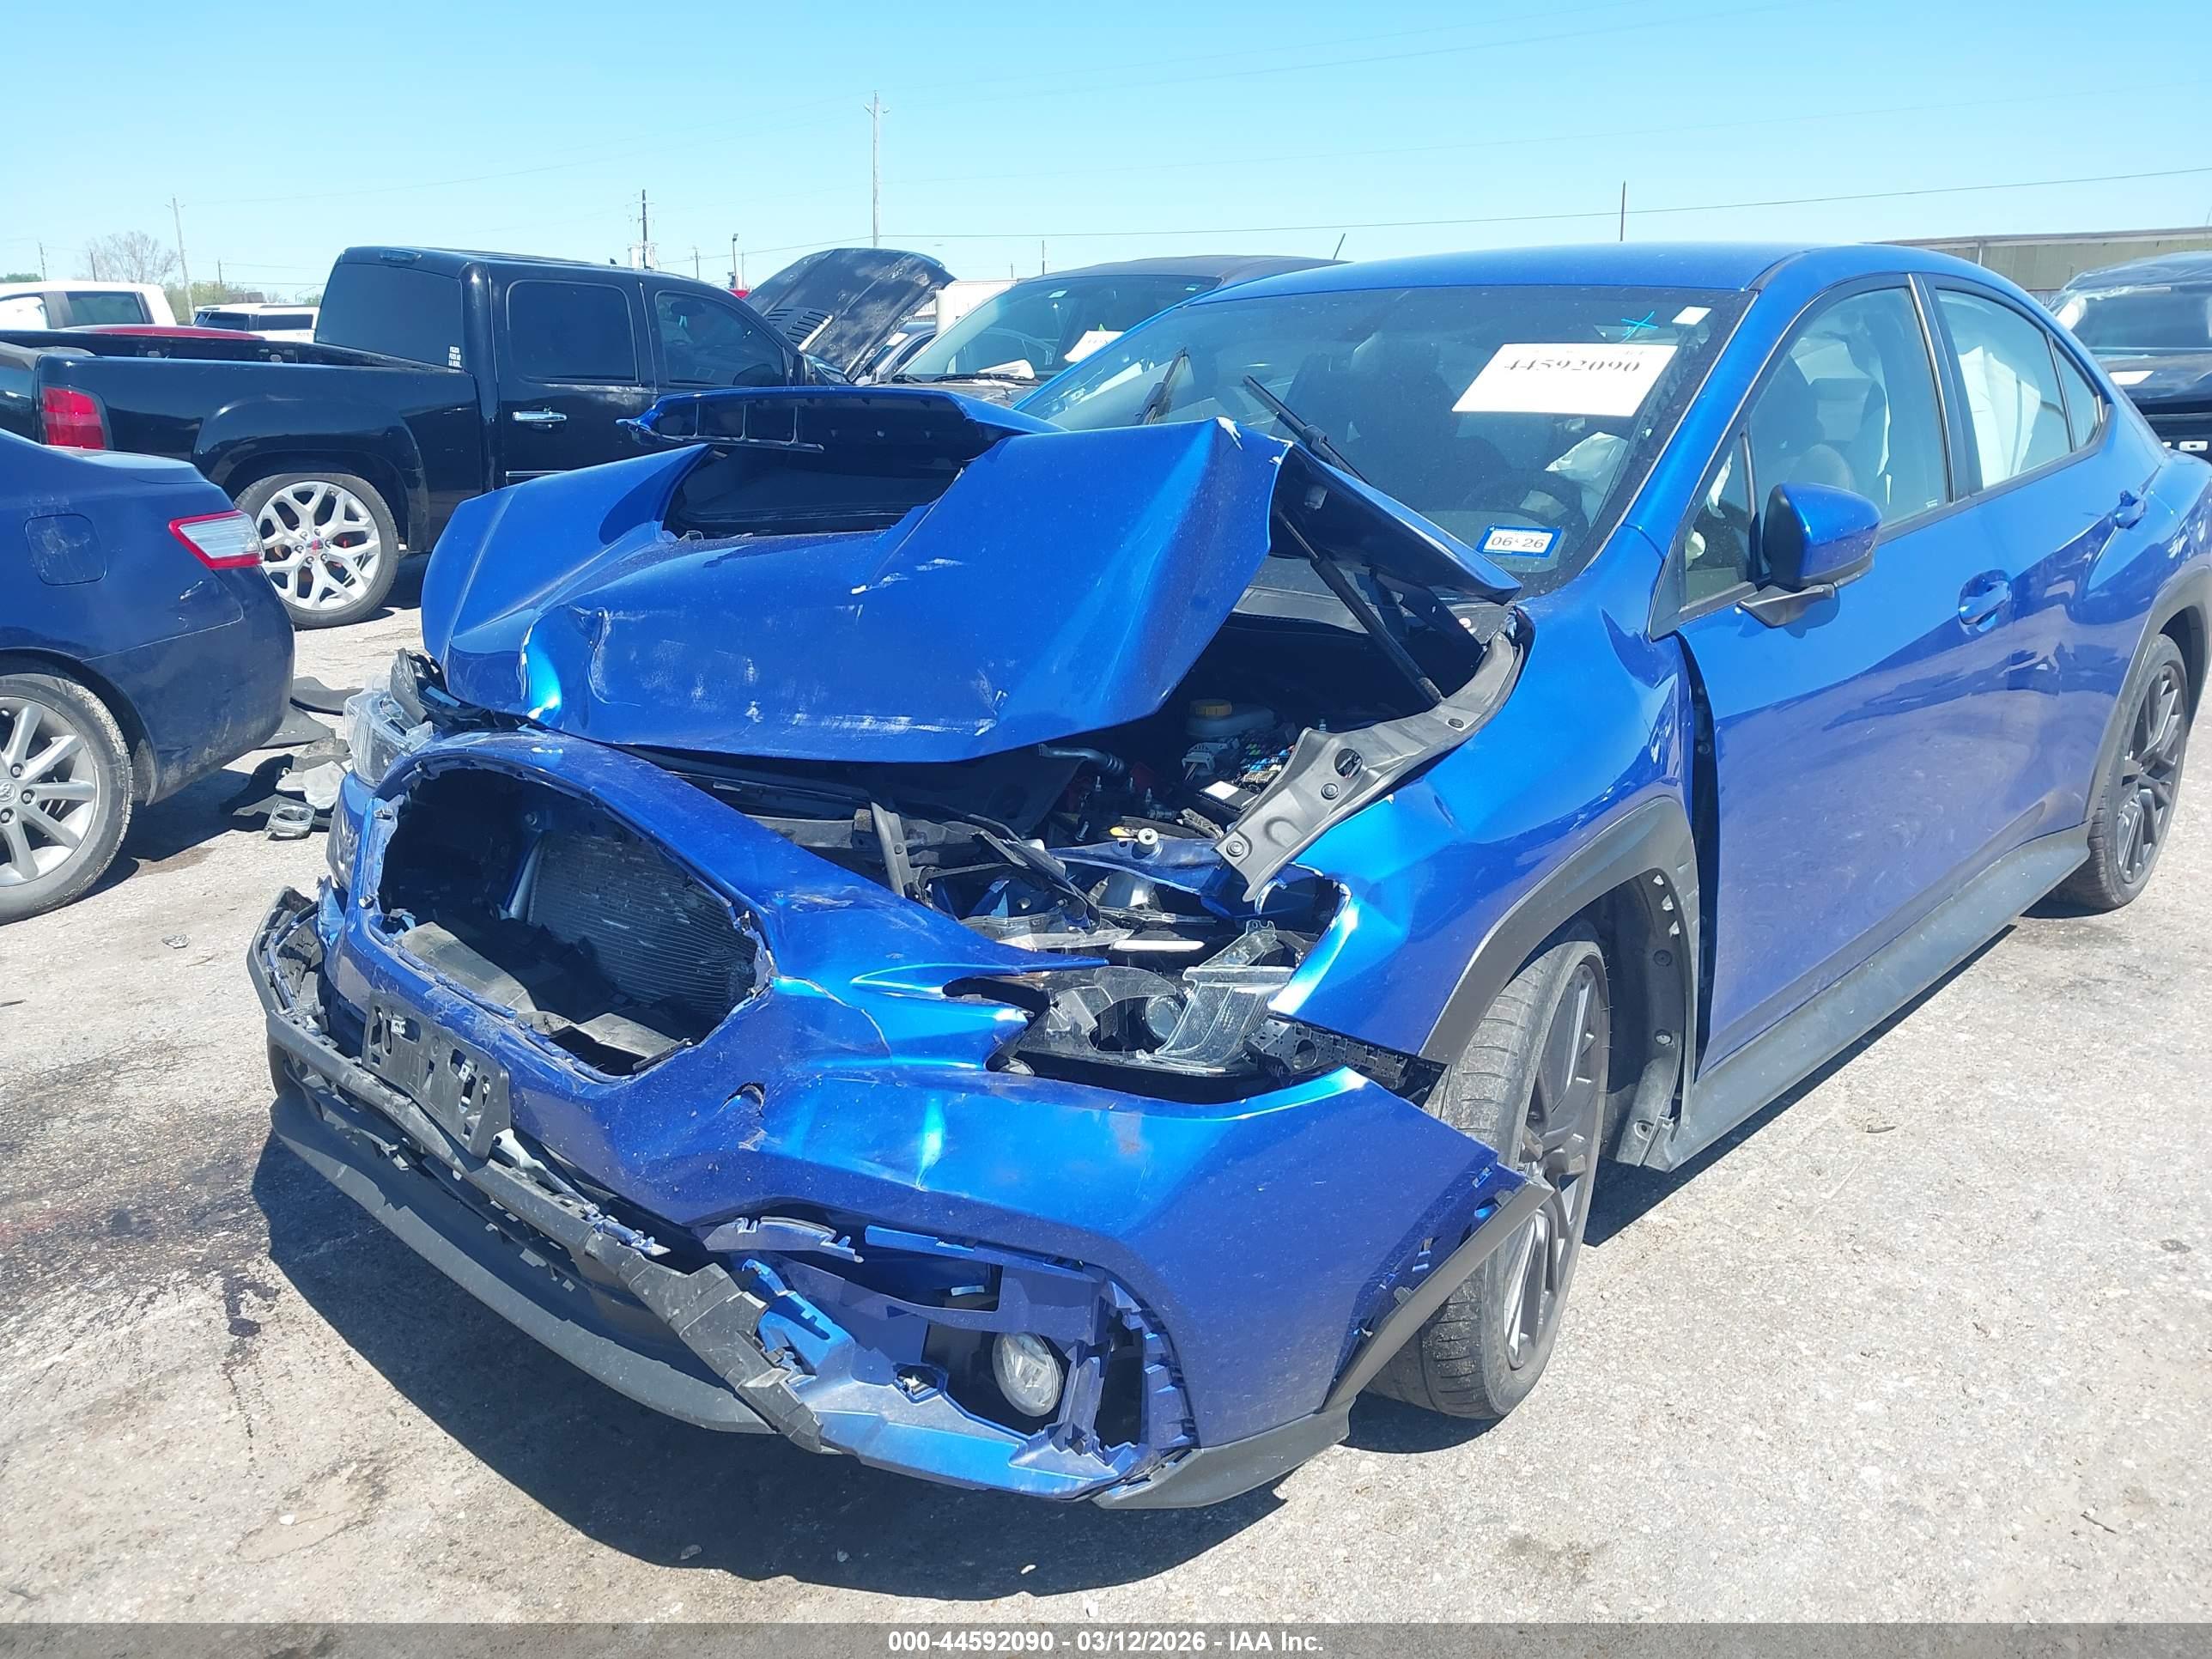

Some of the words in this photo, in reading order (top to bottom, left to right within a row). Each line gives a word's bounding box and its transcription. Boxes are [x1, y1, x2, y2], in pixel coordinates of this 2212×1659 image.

[1504, 359, 1641, 371] 44592090
[1491, 536, 1513, 546] 06
[1522, 538, 1545, 548] 26
